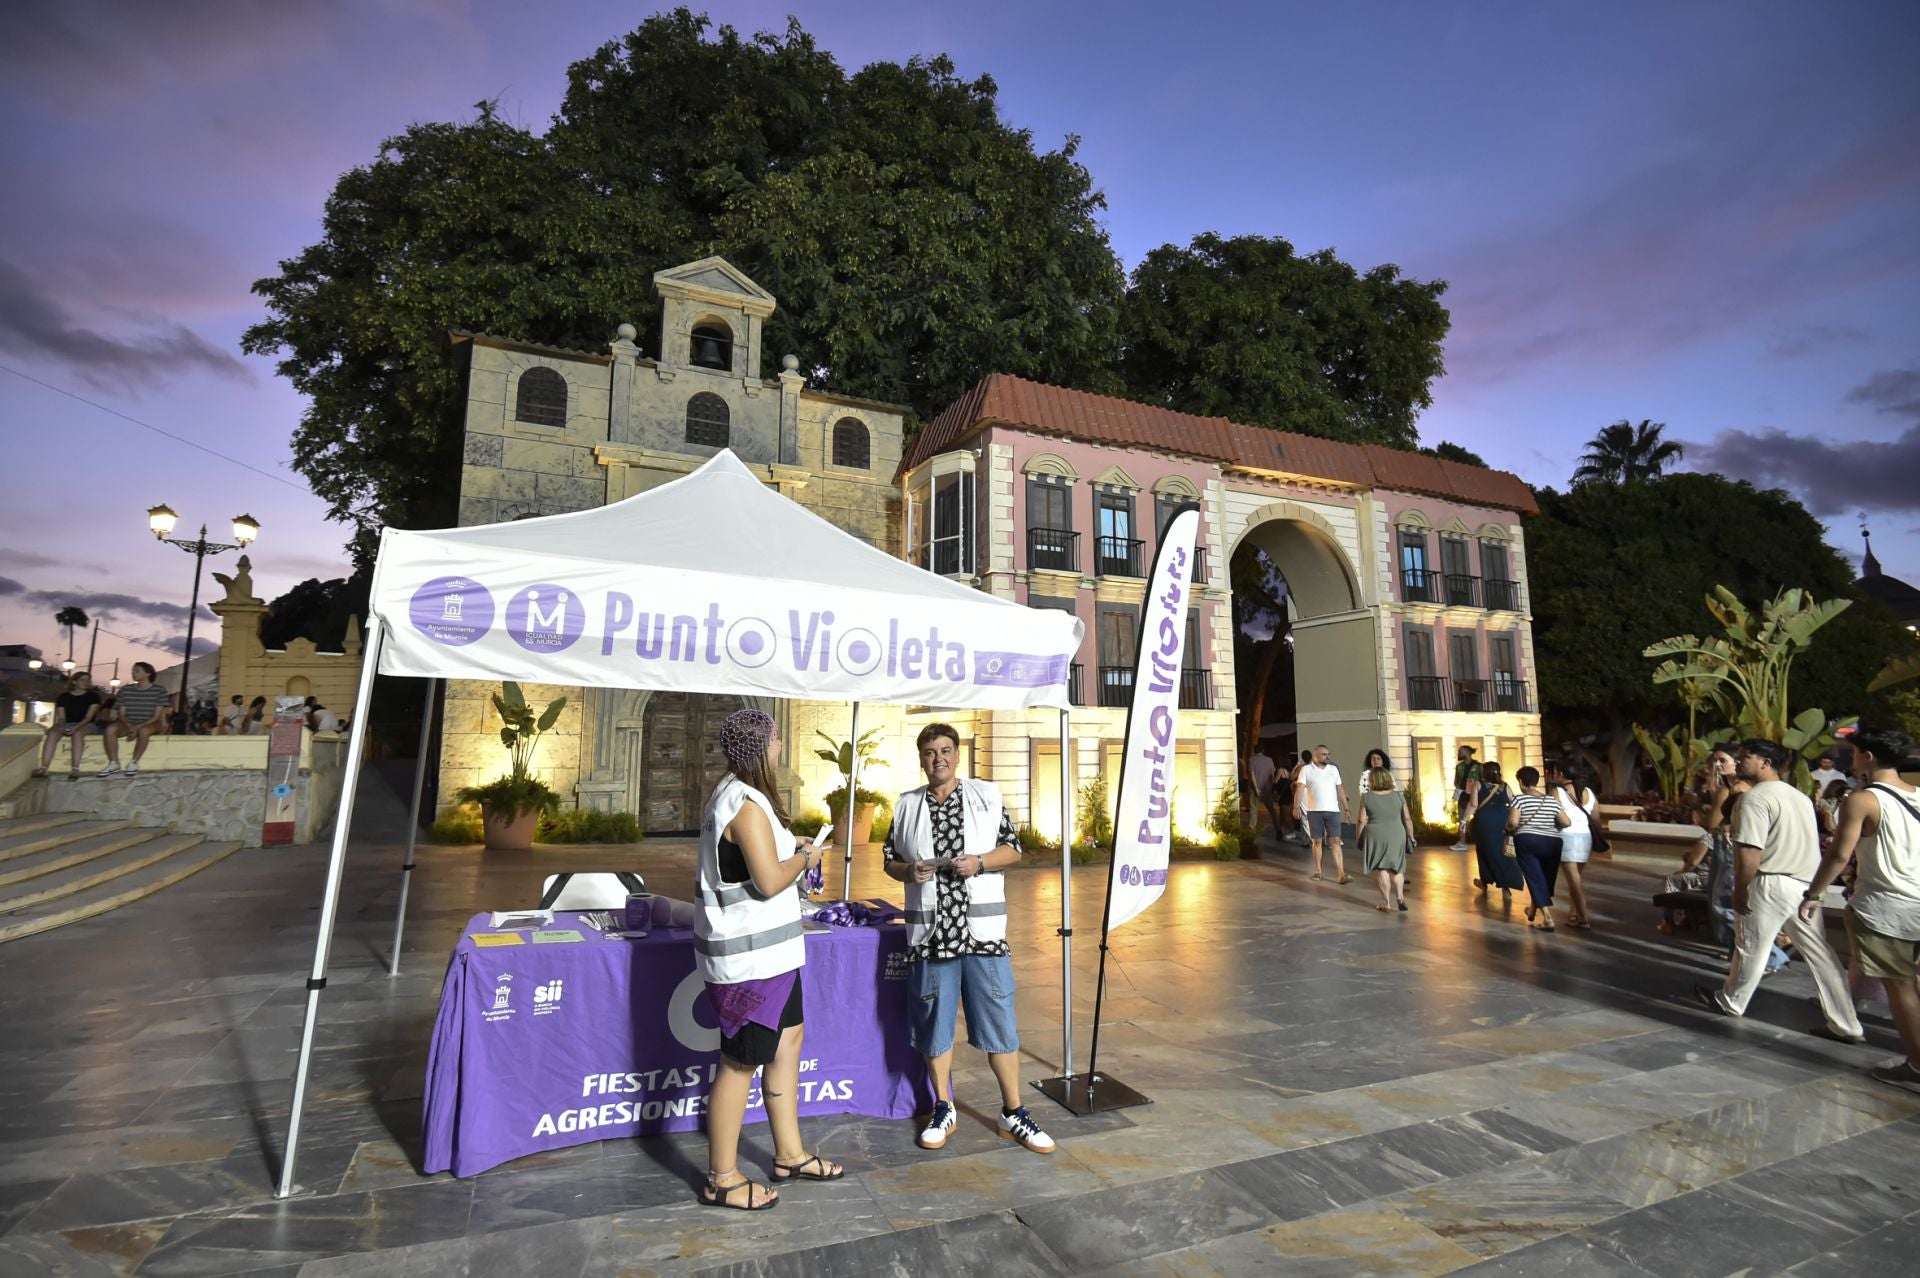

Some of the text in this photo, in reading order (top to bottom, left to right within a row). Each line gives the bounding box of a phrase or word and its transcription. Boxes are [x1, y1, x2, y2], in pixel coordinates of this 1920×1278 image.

[427, 624, 476, 633] Ayuntamiento
[525, 632, 563, 640] IGUALDAD
[601, 590, 966, 682] Punto Violeta
[1138, 705, 1172, 844] Punto
[582, 1065, 702, 1097] FIESTAS
[799, 1058, 818, 1073] DE
